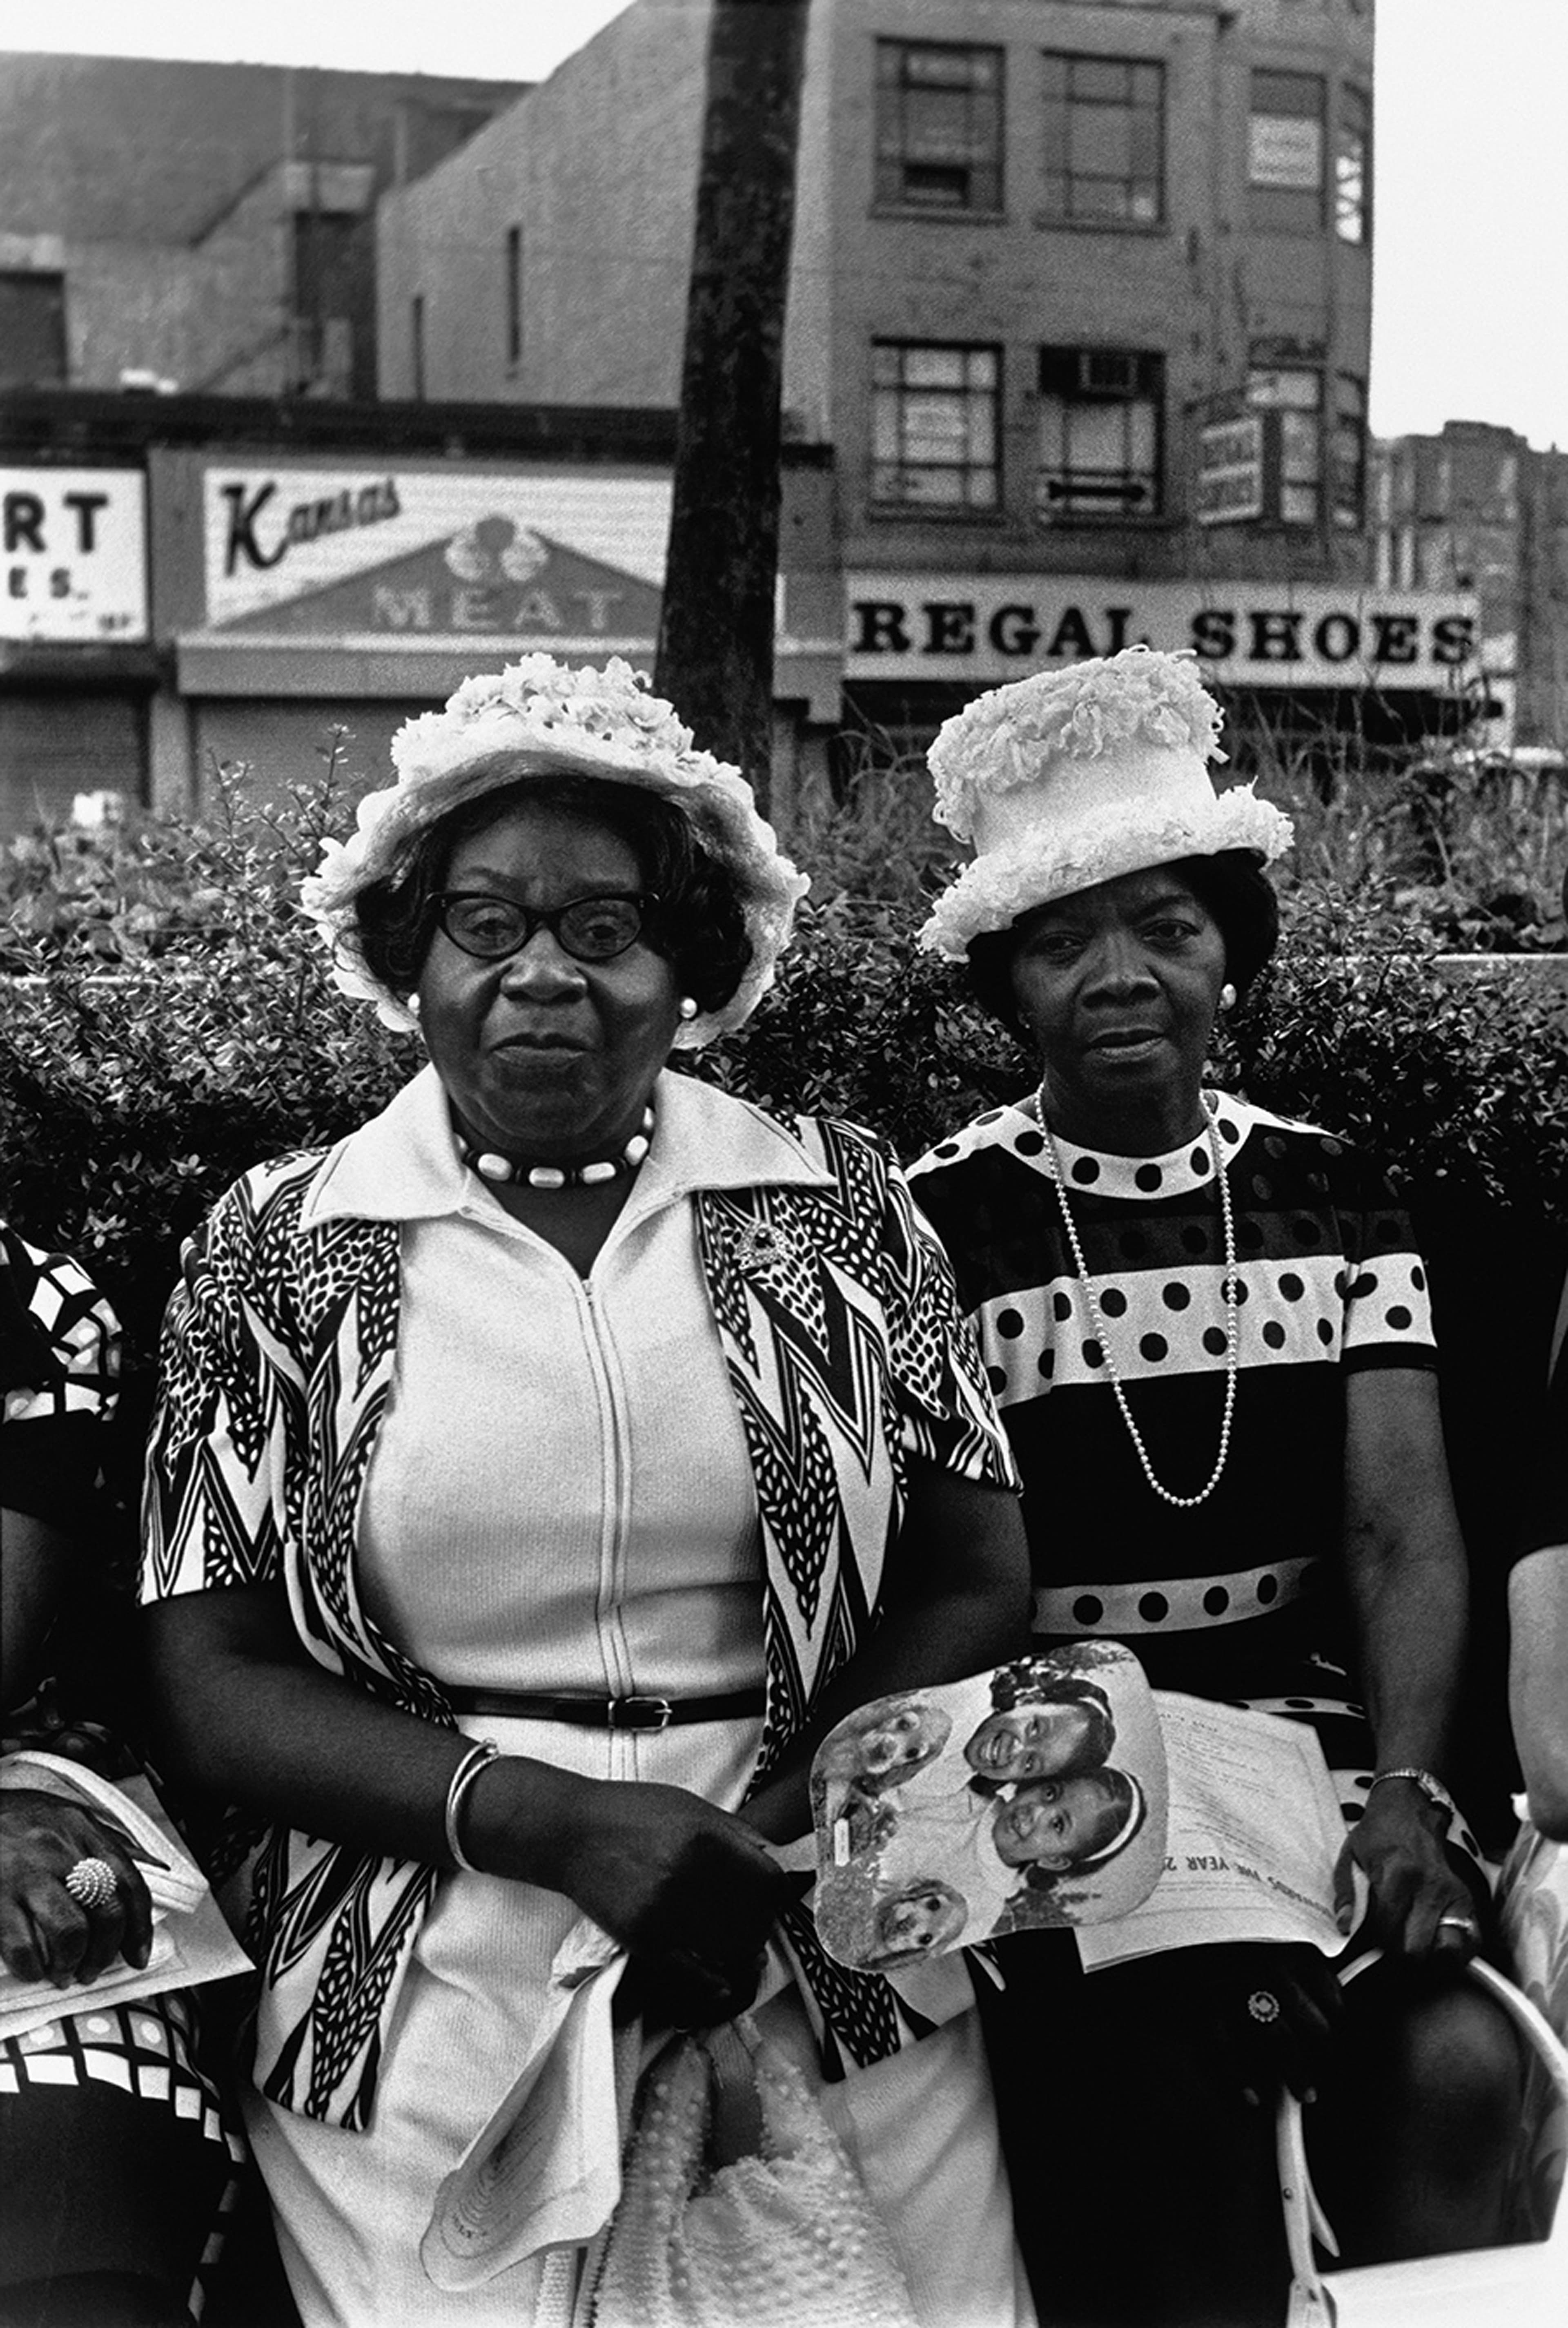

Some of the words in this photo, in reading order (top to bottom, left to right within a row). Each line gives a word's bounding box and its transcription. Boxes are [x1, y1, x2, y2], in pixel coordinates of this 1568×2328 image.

[220, 477, 400, 578] Kansas
[372, 586, 622, 630] MEAT
[851, 600, 1149, 658] REGAL
[1191, 610, 1473, 663] SHOES
[1185, 1856, 1230, 1871] YEAR
